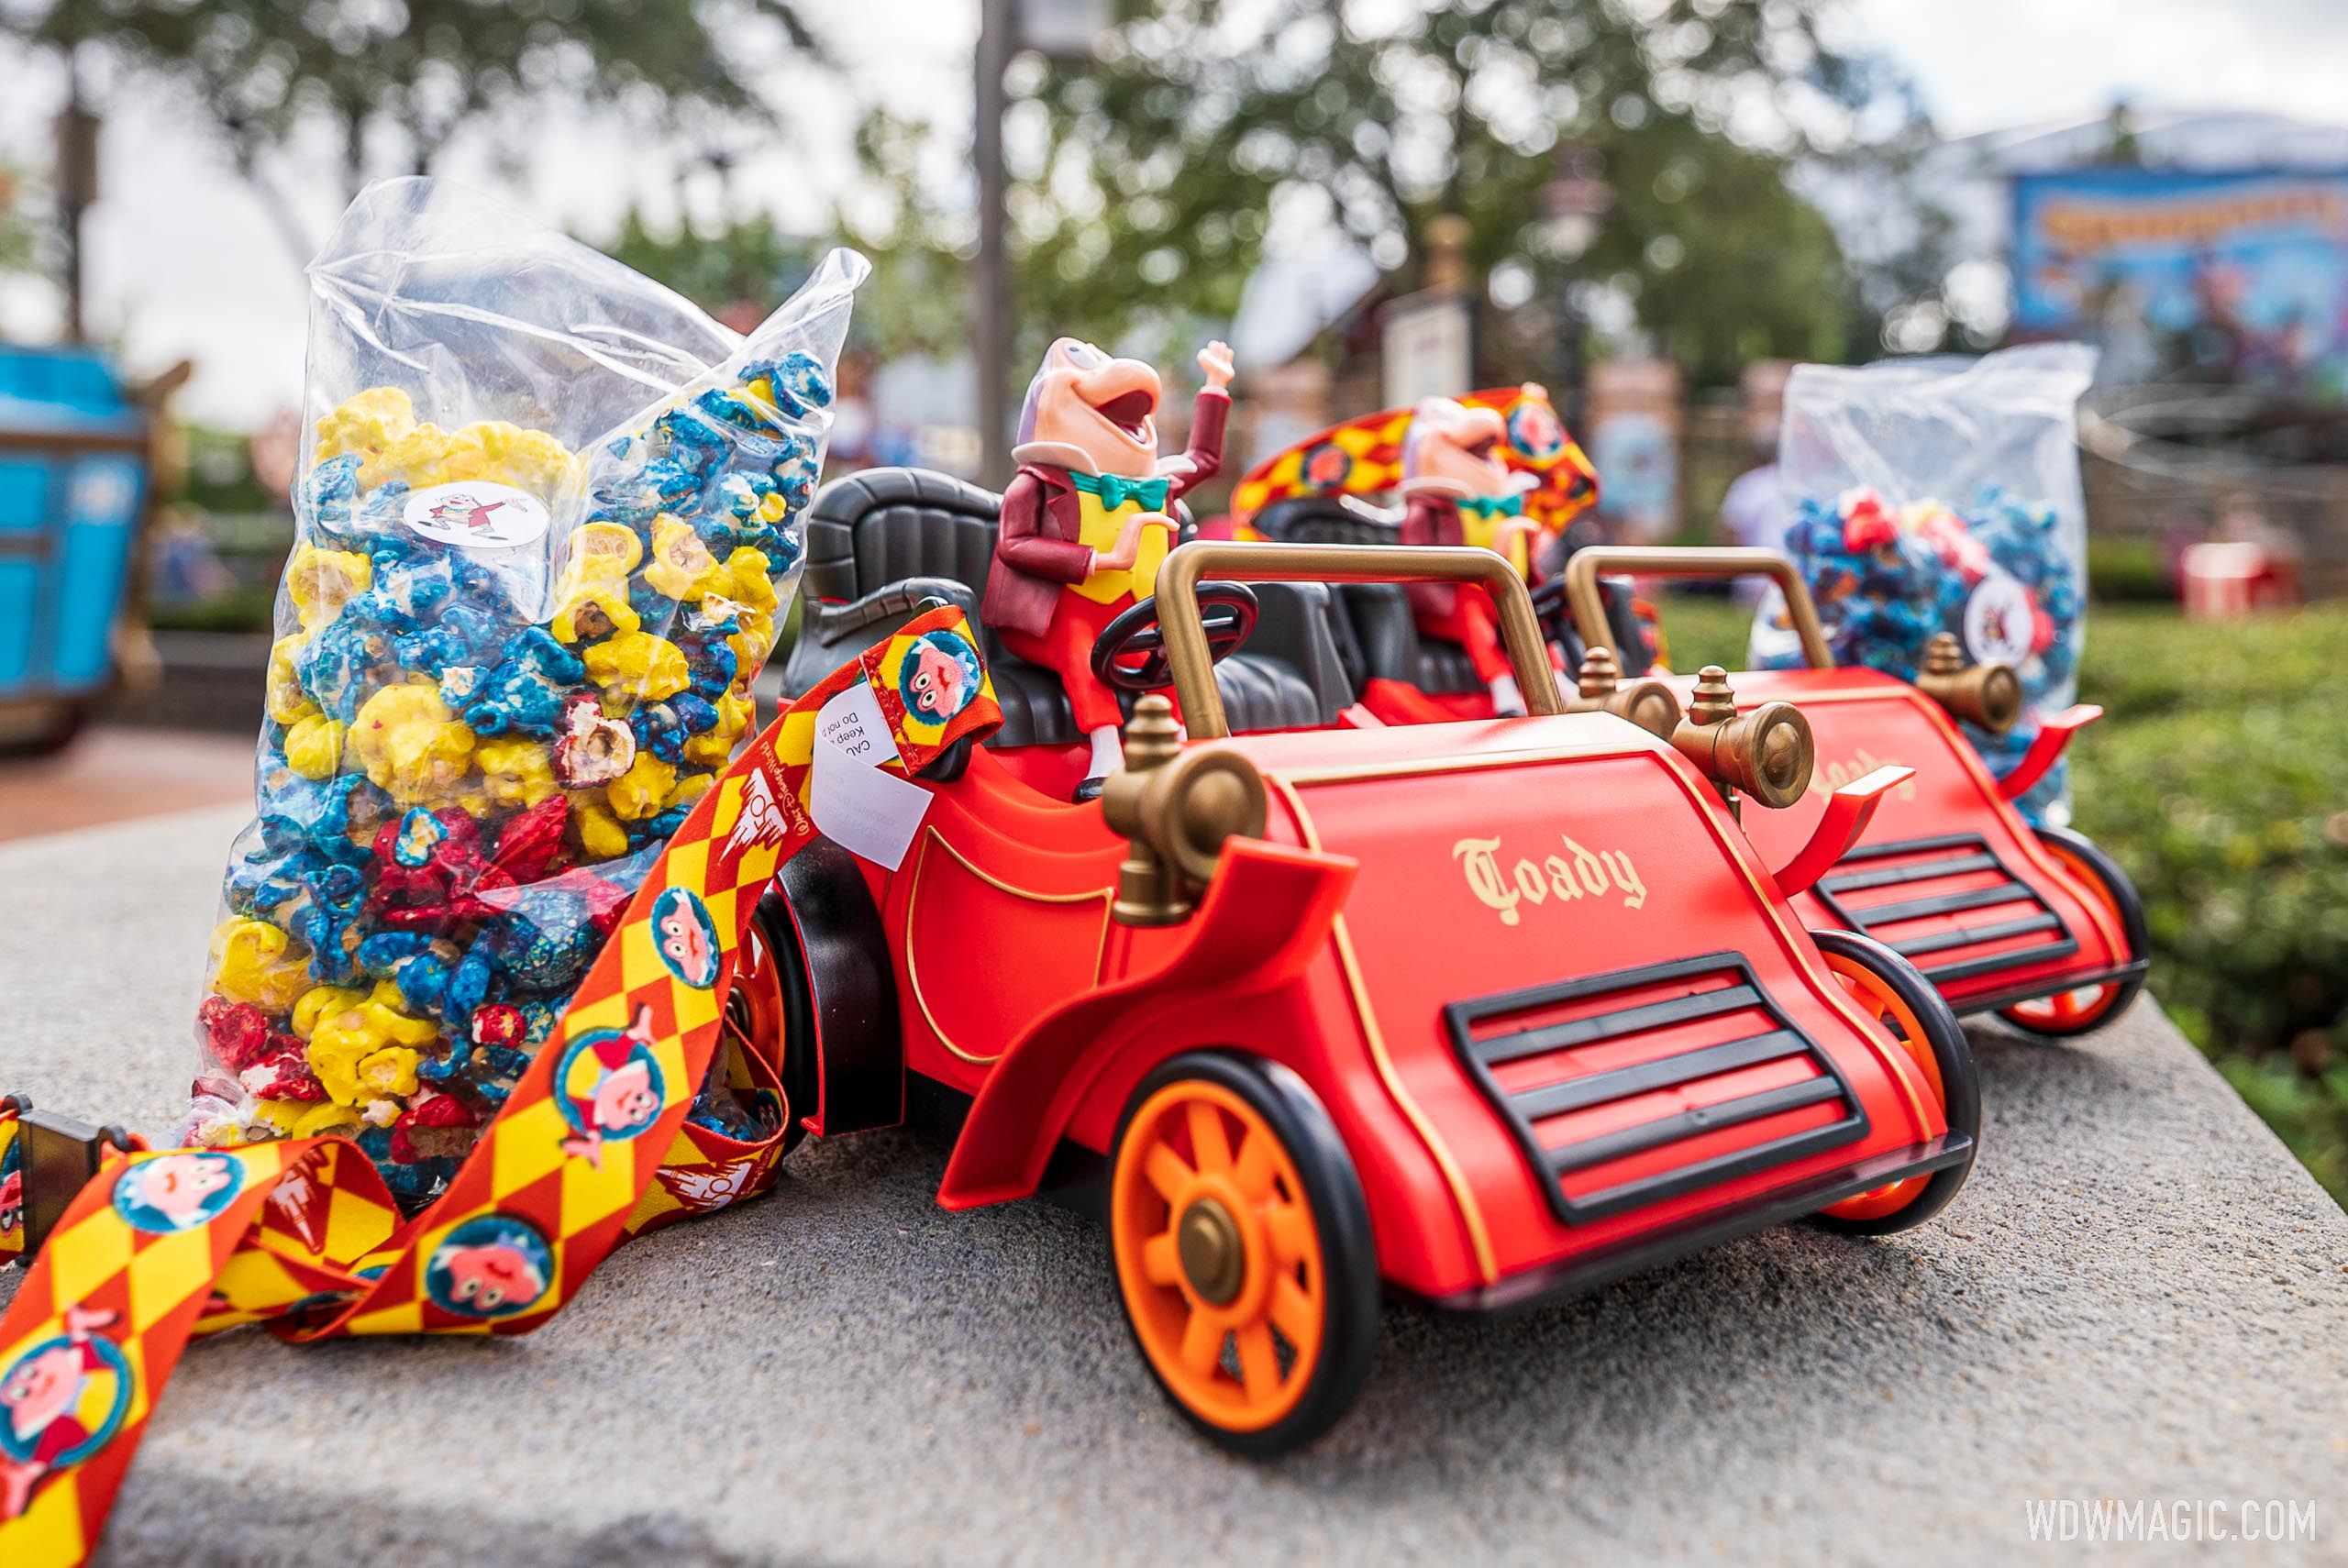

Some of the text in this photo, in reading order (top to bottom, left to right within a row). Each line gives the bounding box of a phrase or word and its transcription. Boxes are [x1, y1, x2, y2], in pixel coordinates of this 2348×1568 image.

[842, 712, 859, 724] Do
[836, 725, 866, 745] Keep
[759, 740, 777, 772] World
[1452, 833, 1648, 927] Toady
